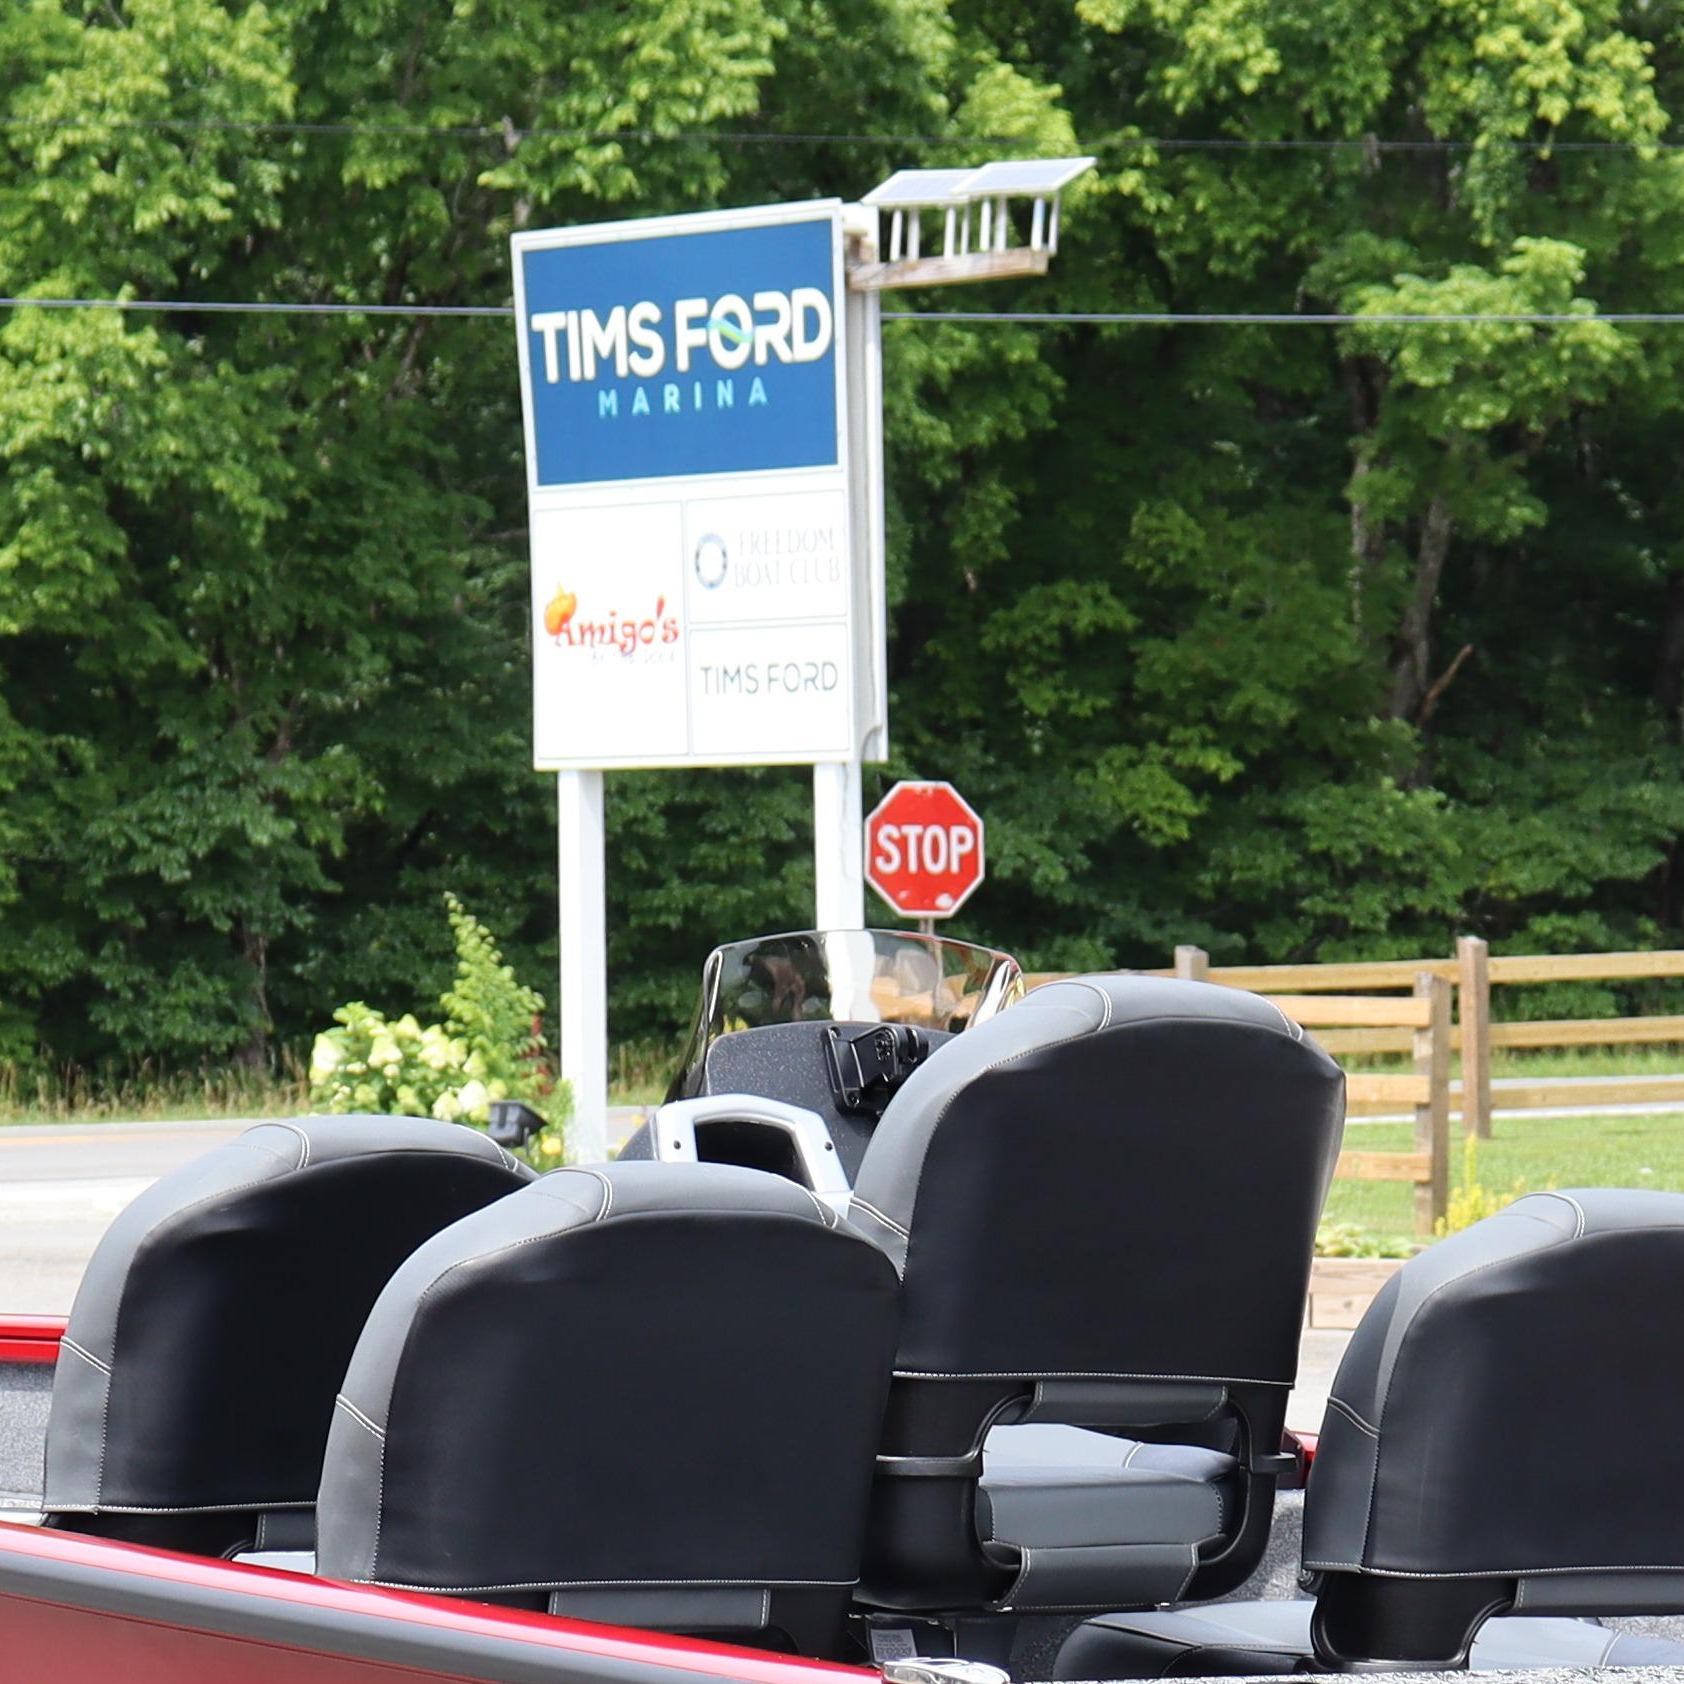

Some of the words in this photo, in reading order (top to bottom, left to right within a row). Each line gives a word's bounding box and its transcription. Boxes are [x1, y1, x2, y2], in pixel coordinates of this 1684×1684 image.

[531, 299, 665, 386] TIMS
[675, 286, 832, 372] FORD
[597, 376, 769, 418] MARINA
[734, 559, 782, 588] BOAT
[788, 555, 841, 586] CLUB
[554, 594, 680, 656] Amigo's
[699, 663, 760, 695] TIMS
[766, 659, 839, 694] FORD
[875, 824, 975, 876] STOP
